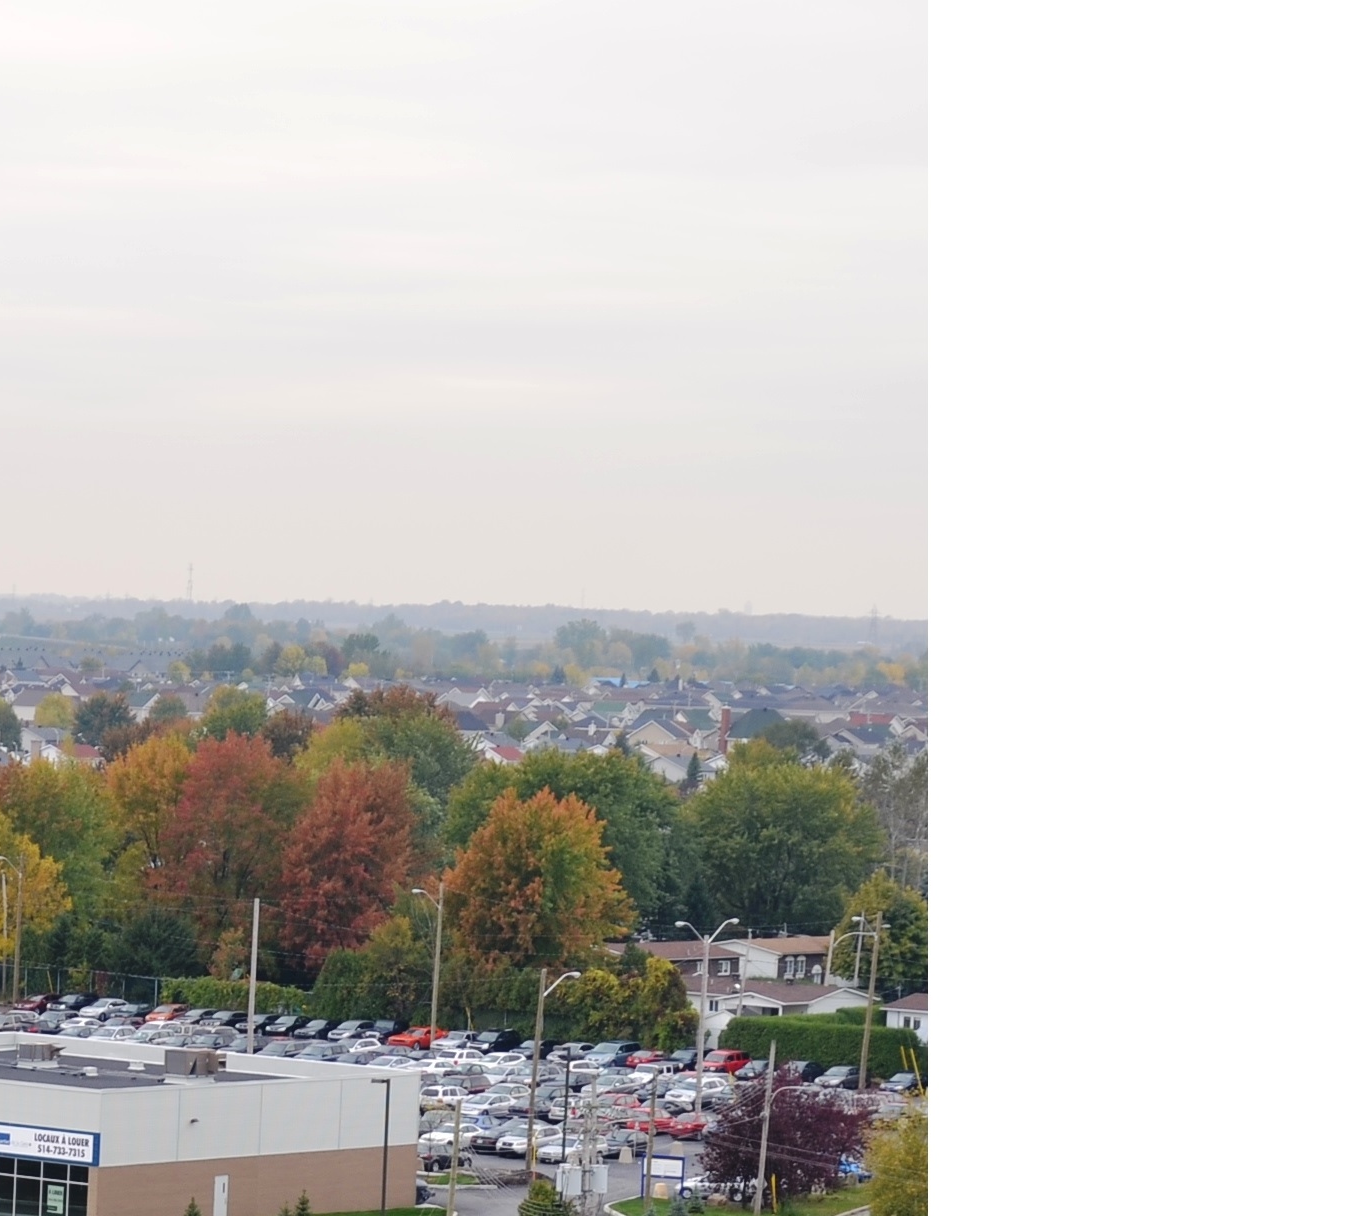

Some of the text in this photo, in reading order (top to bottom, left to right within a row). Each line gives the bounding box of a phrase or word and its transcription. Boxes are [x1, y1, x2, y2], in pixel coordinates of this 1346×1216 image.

[33, 1132, 90, 1147] LOCAUX À LOUER
[37, 1145, 86, 1158] 514-733-7315
